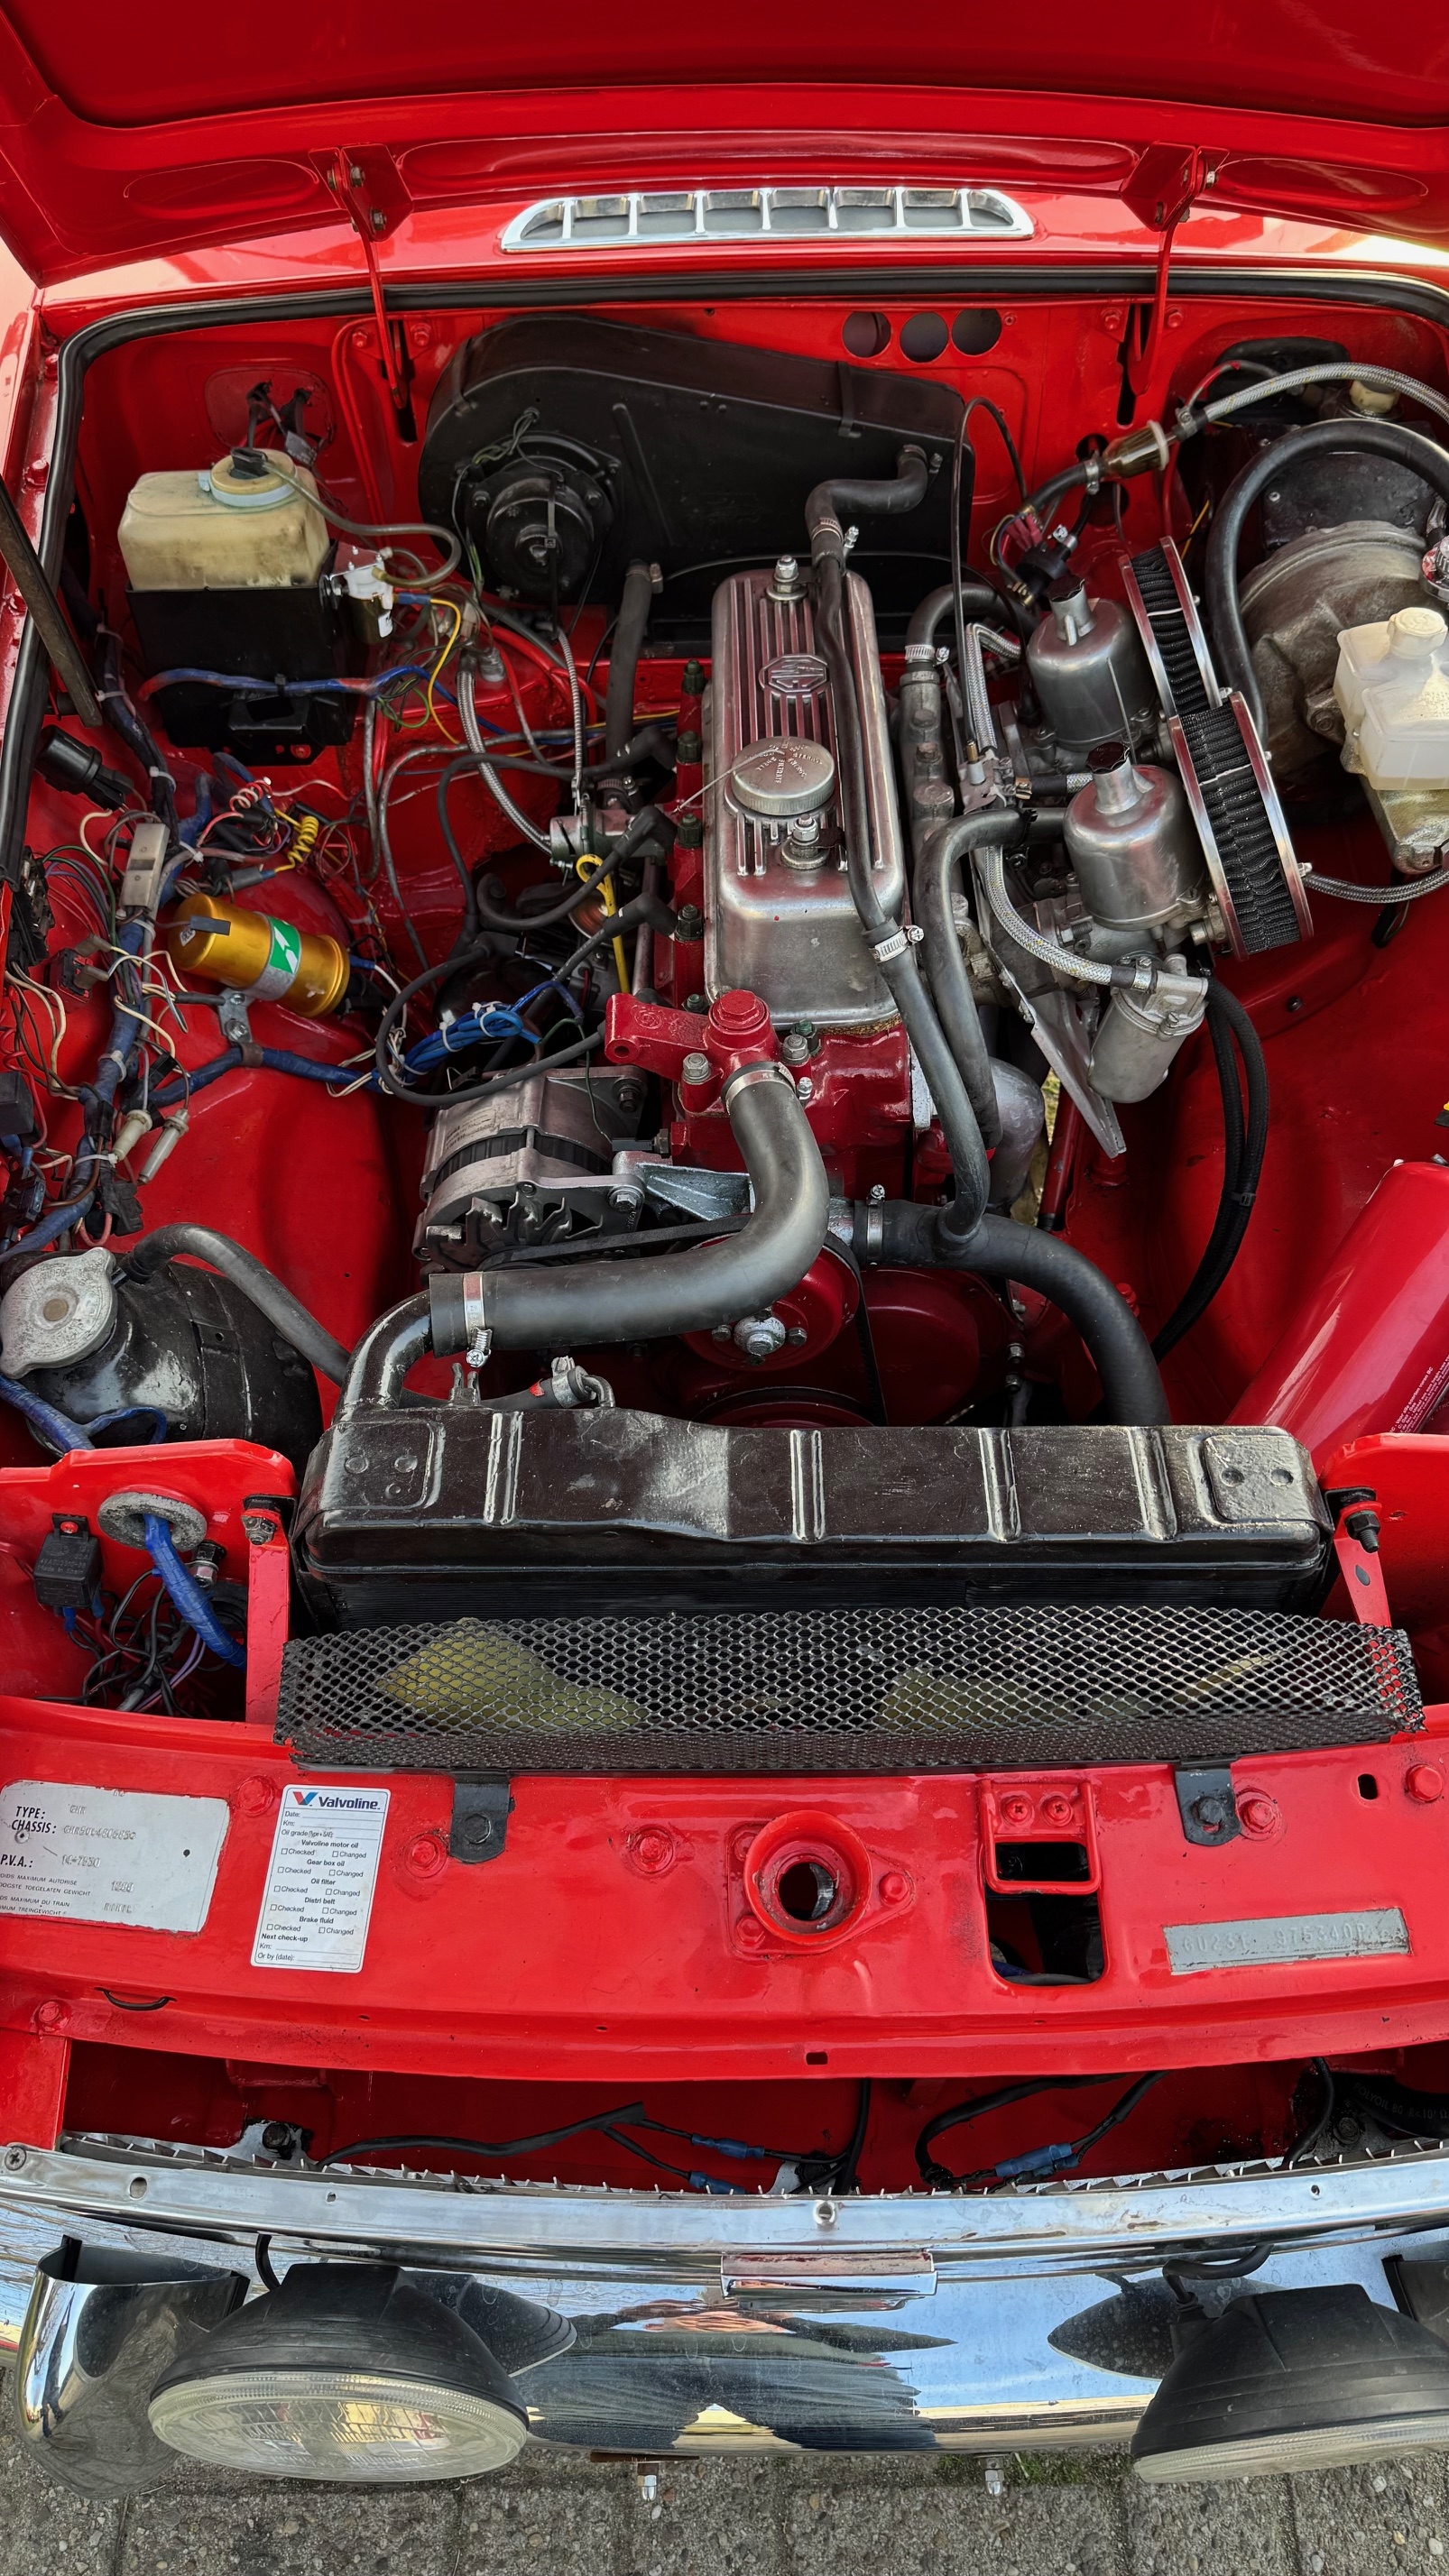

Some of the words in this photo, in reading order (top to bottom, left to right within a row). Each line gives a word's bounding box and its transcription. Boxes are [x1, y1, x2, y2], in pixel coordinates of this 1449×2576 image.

[318, 1797, 379, 1809] Valvoline
[15, 1806, 45, 1819] TYPE:
[11, 1819, 57, 1834] CHASSIS:
[301, 1839, 329, 1847] Valvoline
[0, 1854, 33, 1868] P.V.A.:
[339, 1852, 367, 1860] Changed
[336, 1870, 364, 1878] Changed
[49, 1878, 78, 1886] AUTORISE
[25, 1884, 61, 1893] TOEGELATEN
[63, 1889, 91, 1897] GEWICHT
[333, 1889, 361, 1897] Changed
[329, 1908, 357, 1917] Changed
[273, 1924, 301, 1932] Checked
[326, 1927, 355, 1936] Changed
[277, 1934, 309, 1942] check-up
[1353, 2082, 1389, 2111] POLYOIL
[1392, 2103, 1404, 2115] 80
